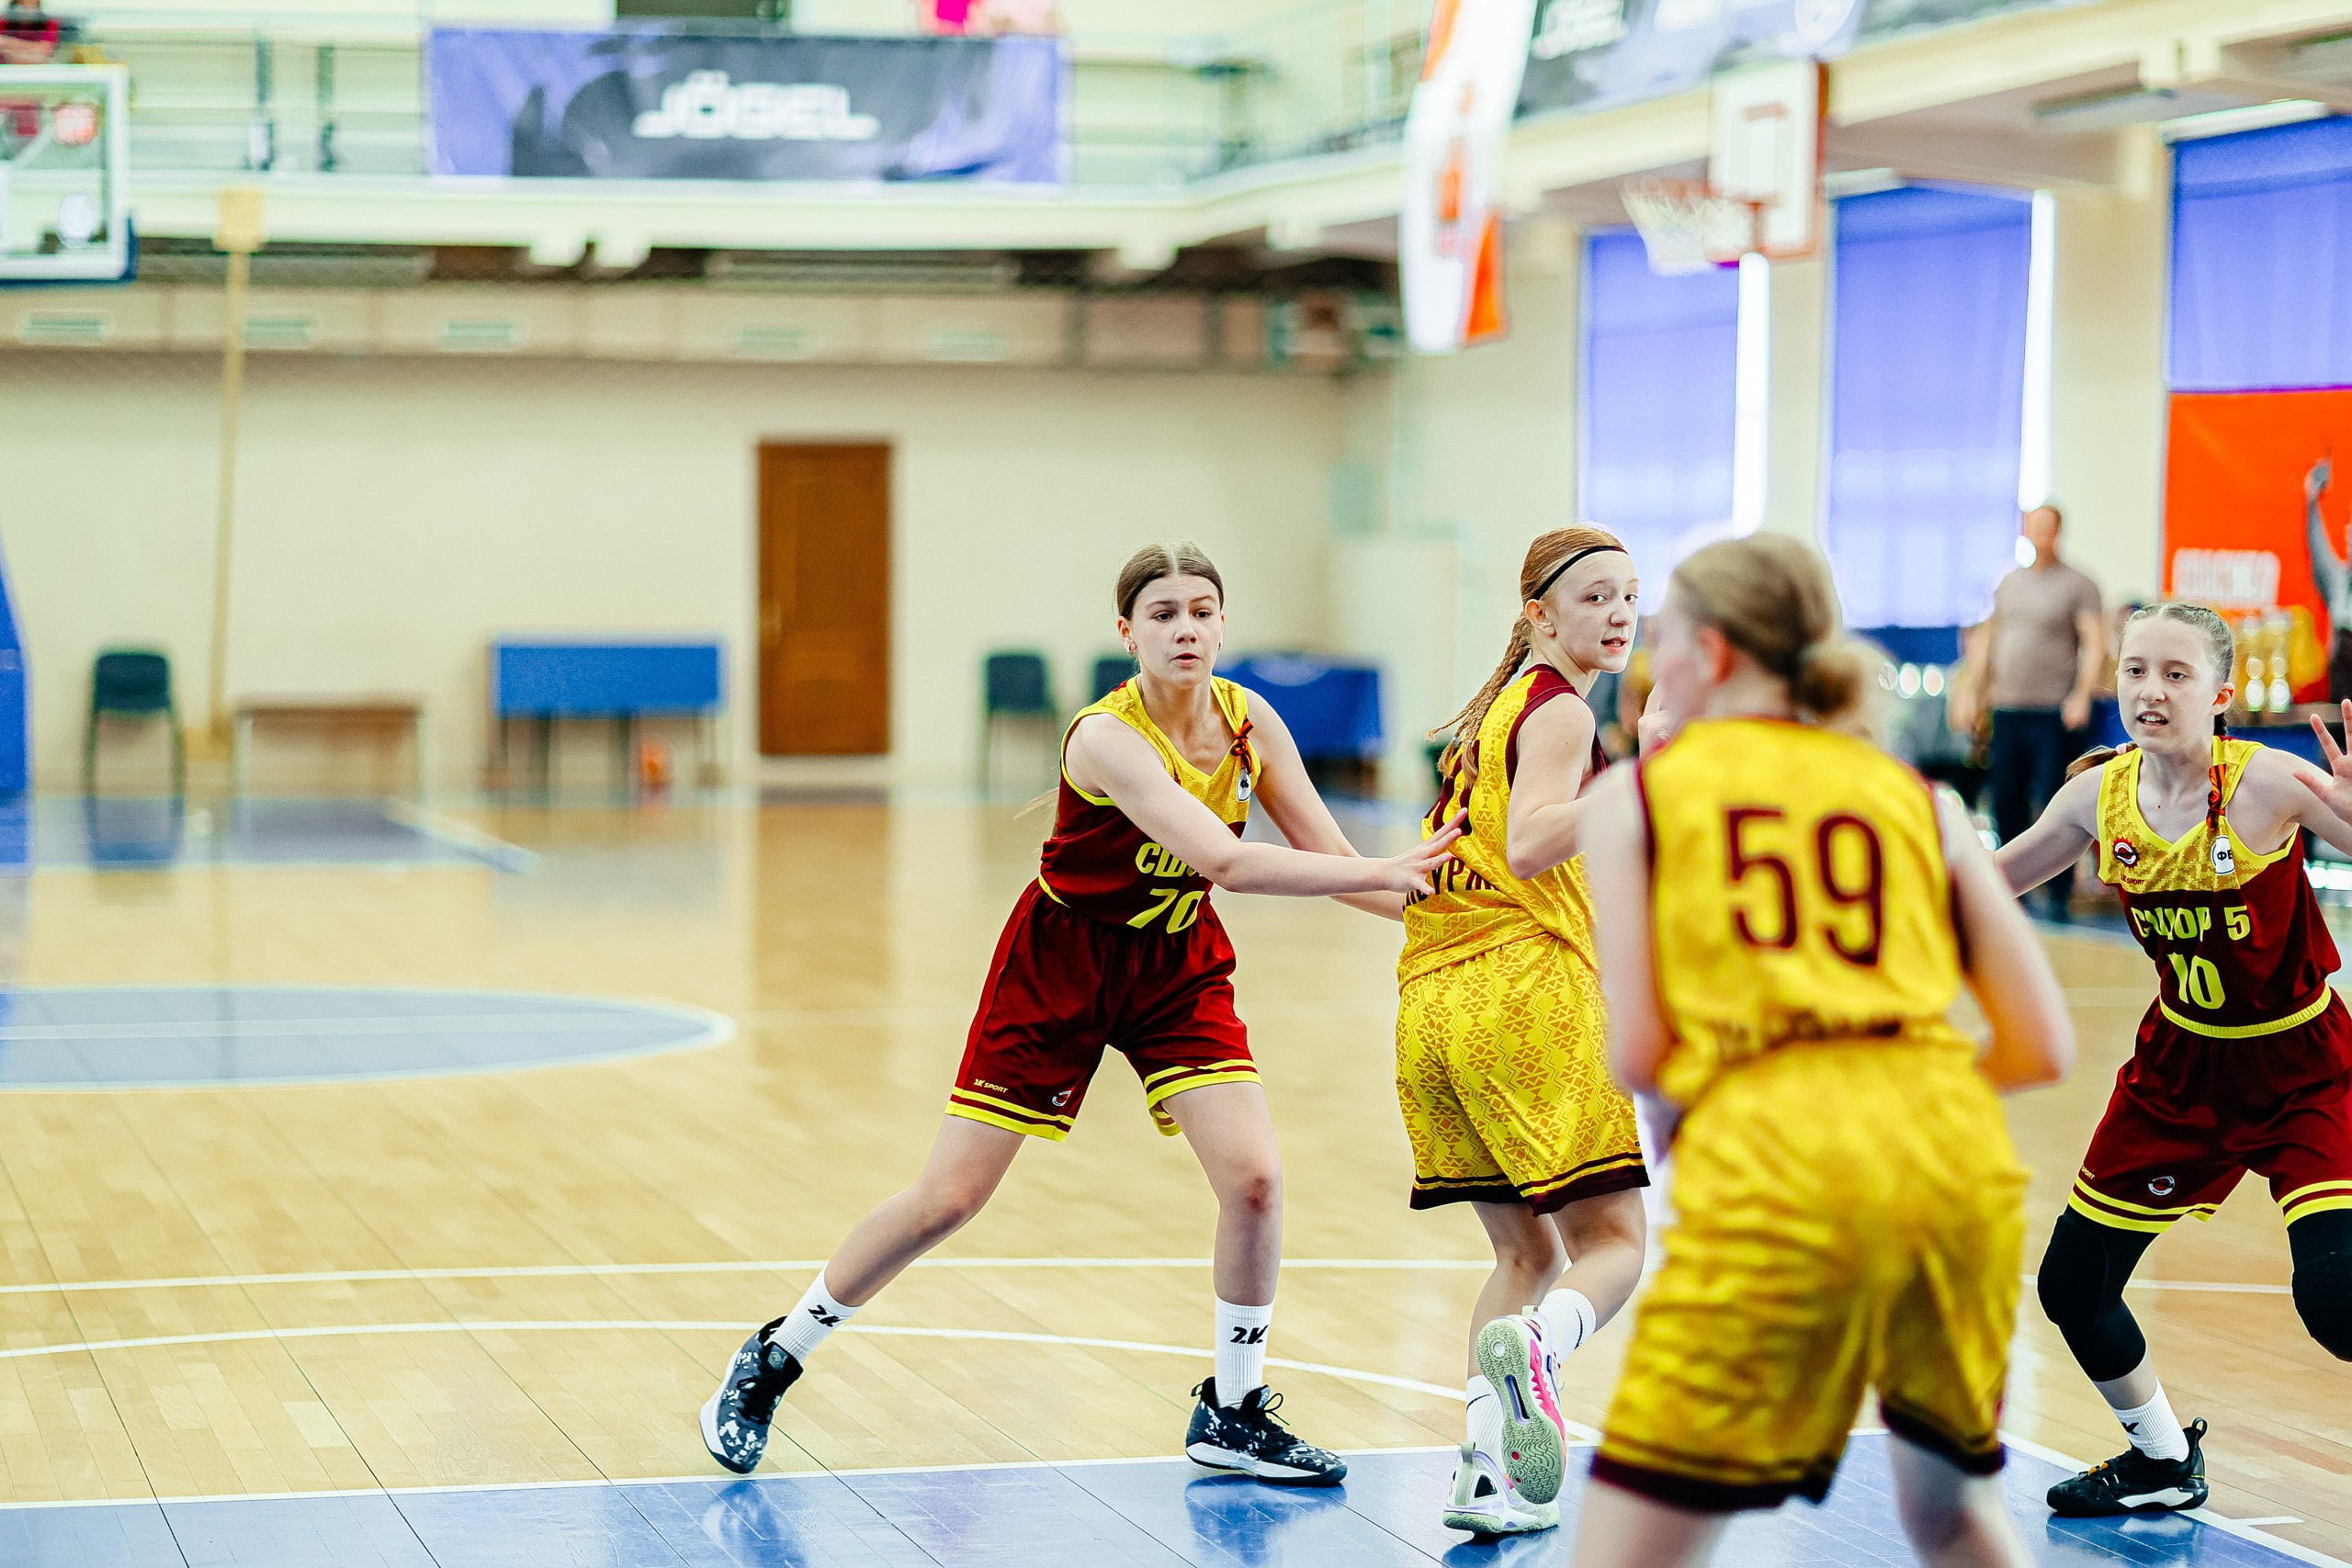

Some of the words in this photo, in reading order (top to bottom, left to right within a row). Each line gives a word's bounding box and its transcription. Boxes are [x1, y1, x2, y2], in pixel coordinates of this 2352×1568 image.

[1135, 842, 1204, 877] СШ
[1724, 806, 1883, 967] 59
[1126, 888, 1205, 934] 70
[2224, 905, 2251, 941] 5
[2167, 952, 2226, 1010] 10
[974, 1078, 985, 1087] 2K
[984, 1082, 1009, 1093] SPORT
[2081, 1166, 2096, 1180] SPORT
[808, 1304, 842, 1327] 2K
[1230, 1324, 1269, 1344] 2K
